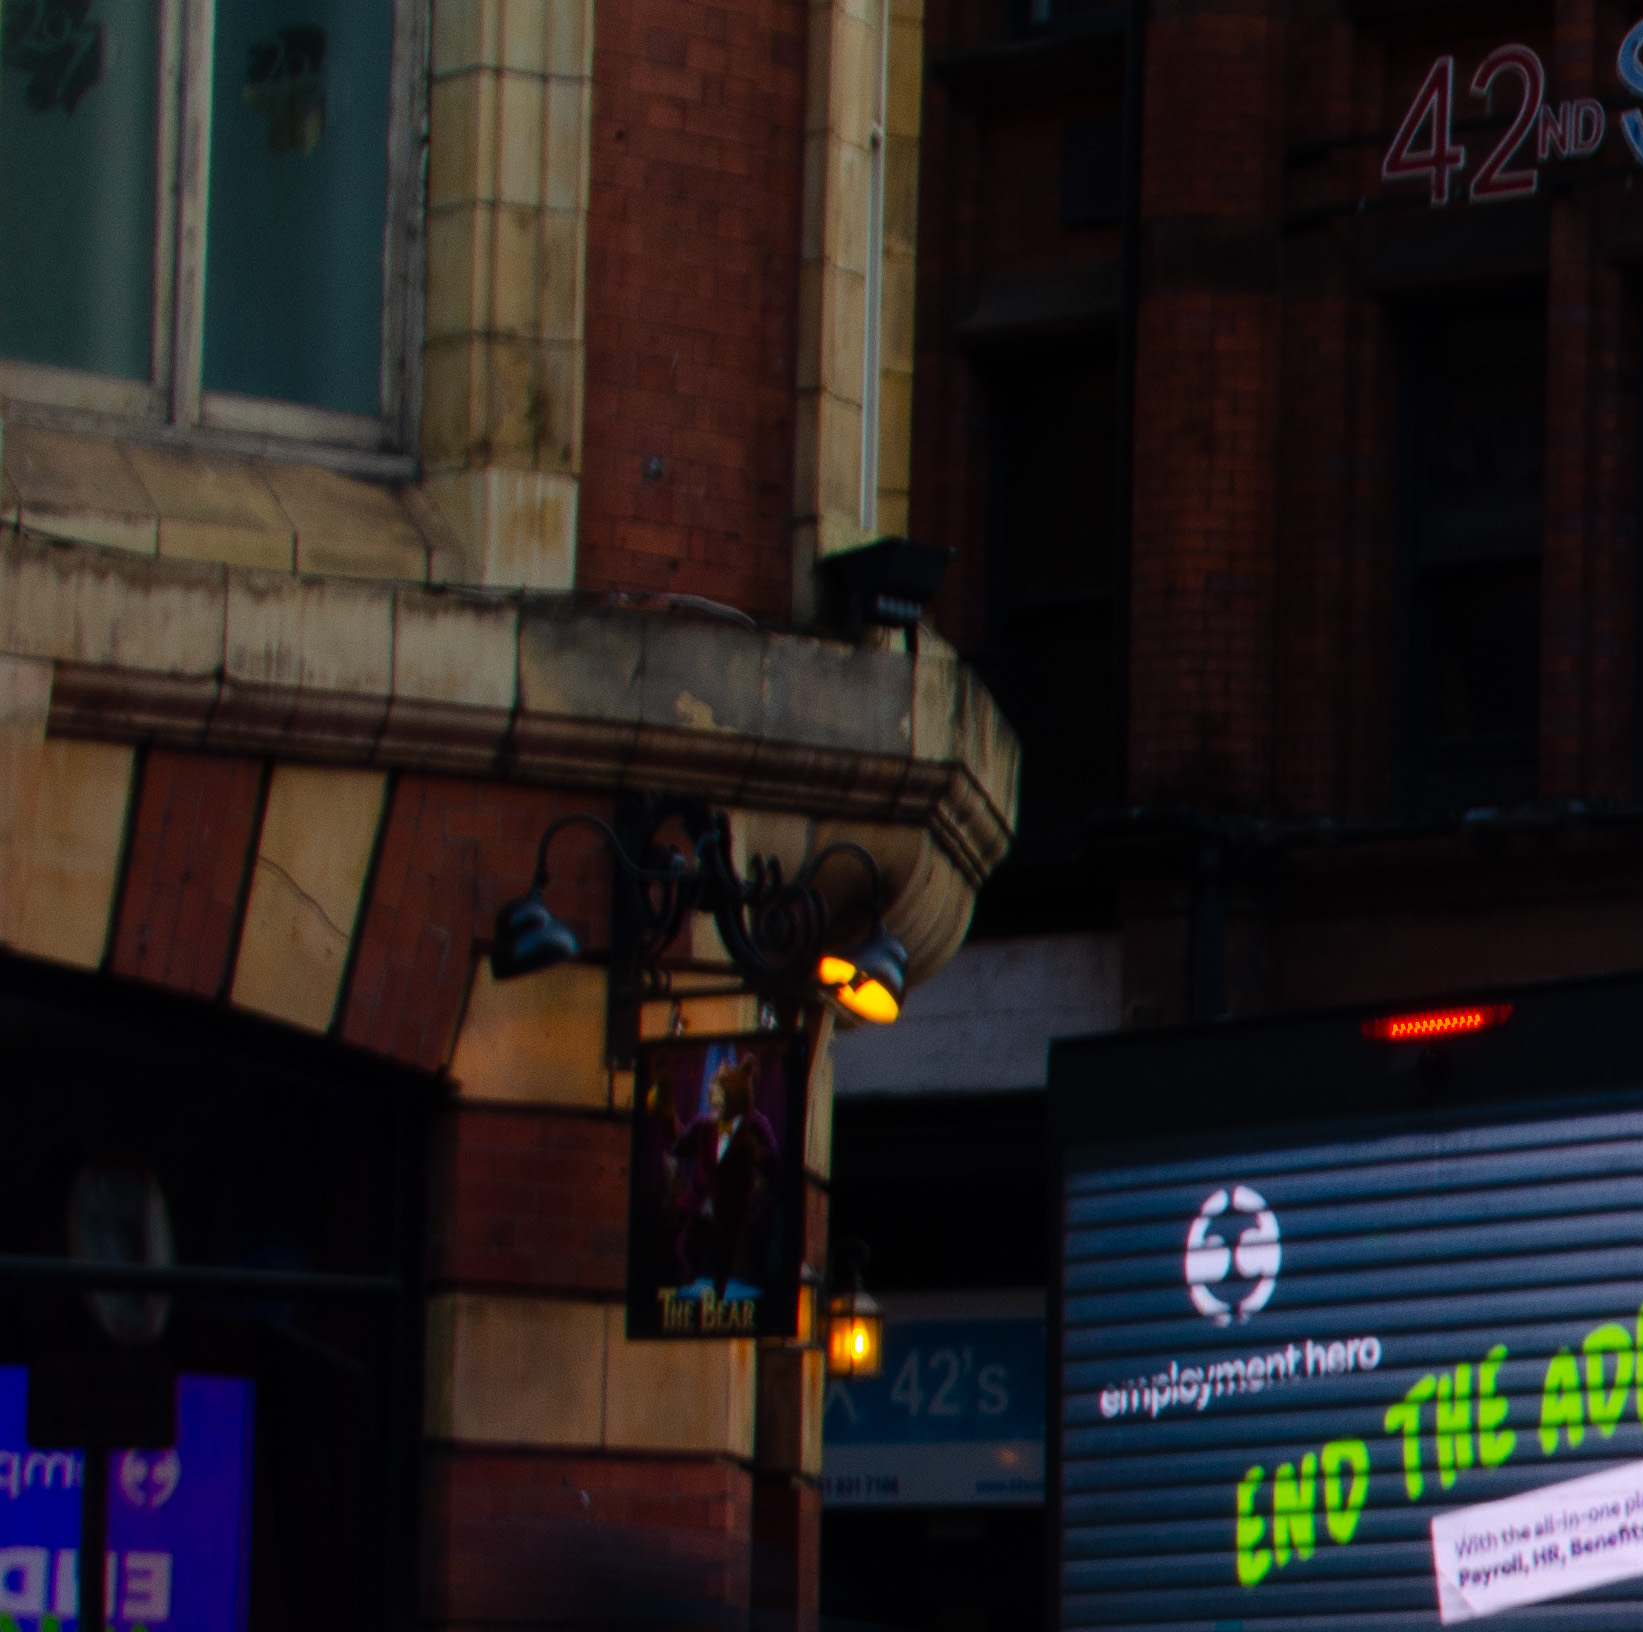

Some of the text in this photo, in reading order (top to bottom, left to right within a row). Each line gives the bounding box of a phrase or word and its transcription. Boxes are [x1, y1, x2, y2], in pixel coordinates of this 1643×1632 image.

[890, 1346, 1008, 1416] 42's
[1100, 1336, 1382, 1418] employment hero
[1236, 1438, 1371, 1586] END
[1385, 1345, 1516, 1500] THE
[1455, 1532, 1498, 1558] With
[1500, 1526, 1531, 1547] the
[1535, 1503, 1622, 1537] all-in-one
[1459, 1553, 1530, 1588] Payroll,
[1533, 1546, 1567, 1569] HR,
